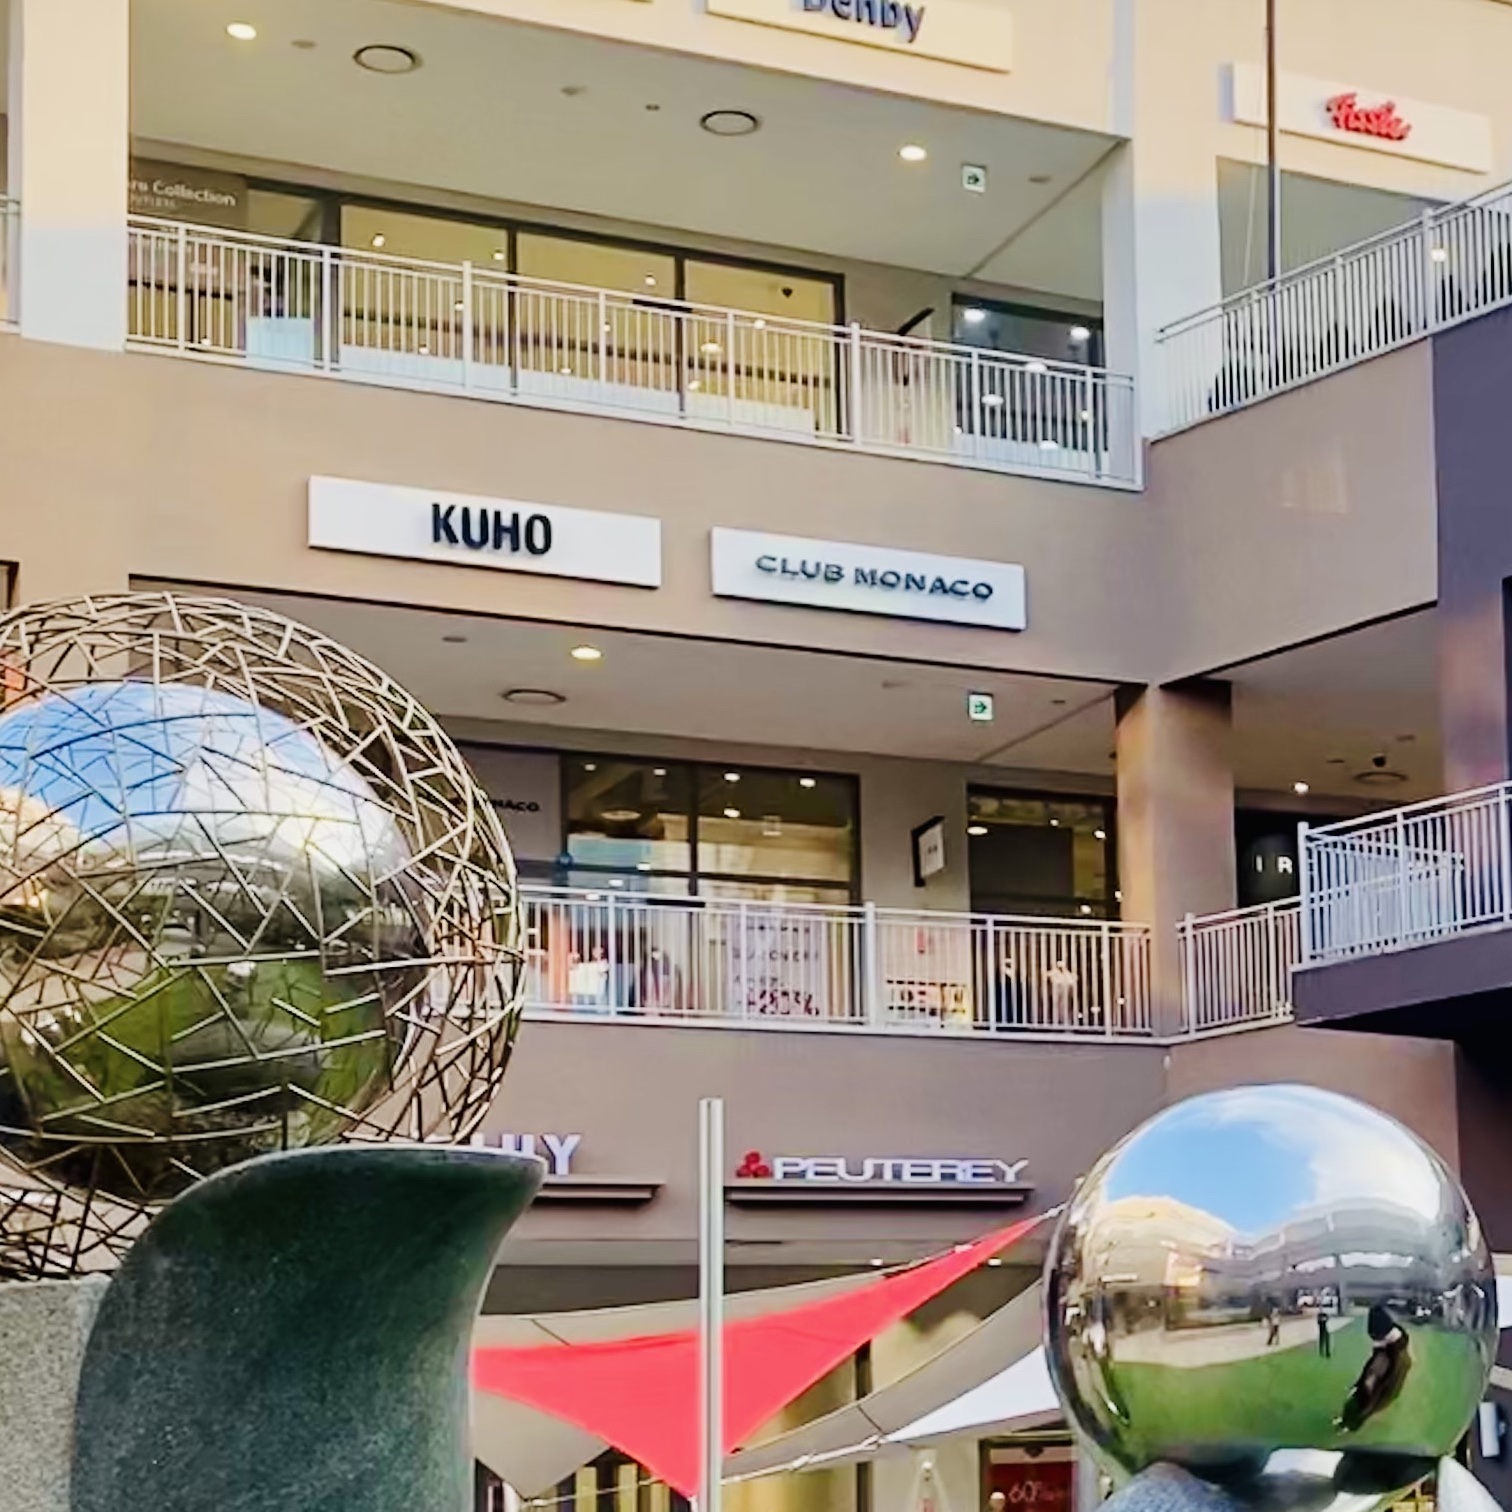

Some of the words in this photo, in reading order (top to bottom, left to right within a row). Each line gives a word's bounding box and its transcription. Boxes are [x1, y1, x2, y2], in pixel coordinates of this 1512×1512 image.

[431, 502, 552, 556] KUHO
[755, 554, 845, 584] CLUB
[853, 566, 994, 601] MONACO
[773, 1156, 1029, 1183] PEUTEREY
